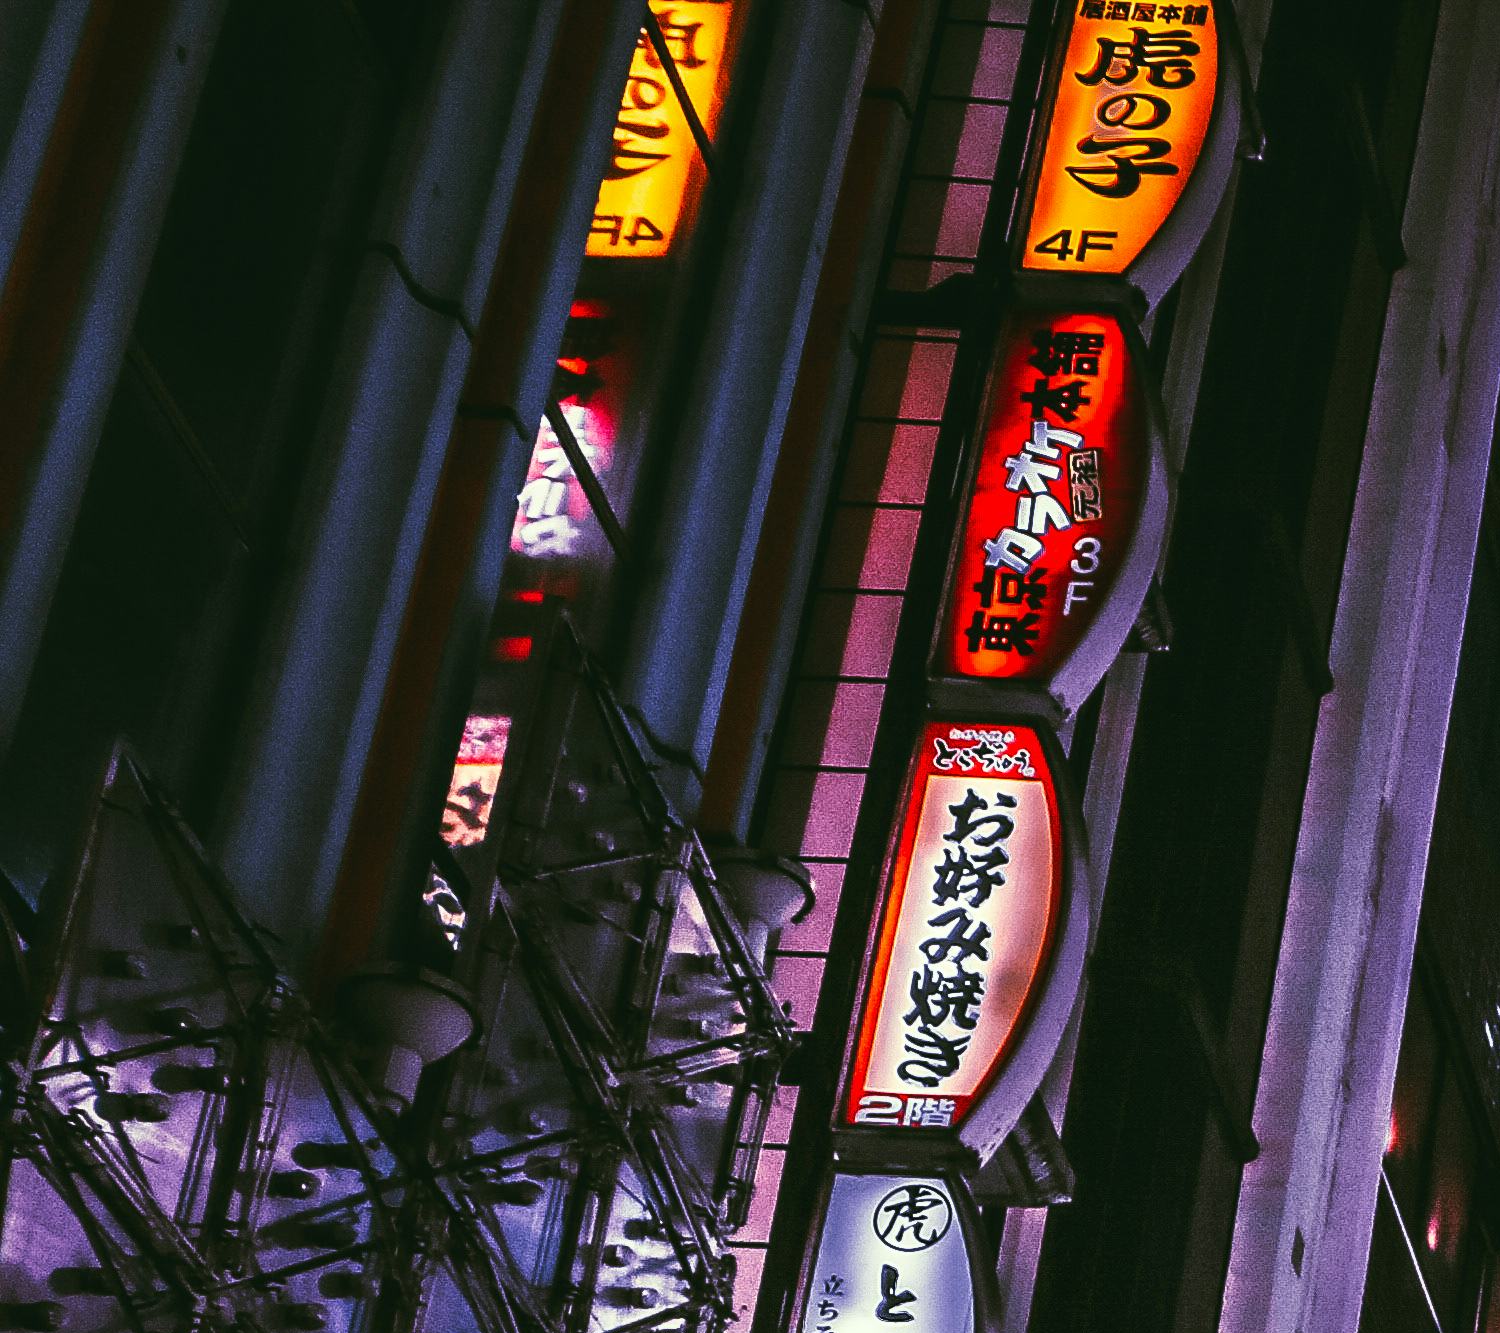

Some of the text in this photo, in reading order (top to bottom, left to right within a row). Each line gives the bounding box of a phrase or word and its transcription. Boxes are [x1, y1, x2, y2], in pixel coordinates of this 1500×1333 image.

[1066, 27, 1196, 198] 虎の子
[1033, 229, 1117, 262] 4F
[897, 787, 1018, 1089] お好み焼き
[853, 1096, 957, 1127] 2階
[884, 1186, 940, 1246] 虎
